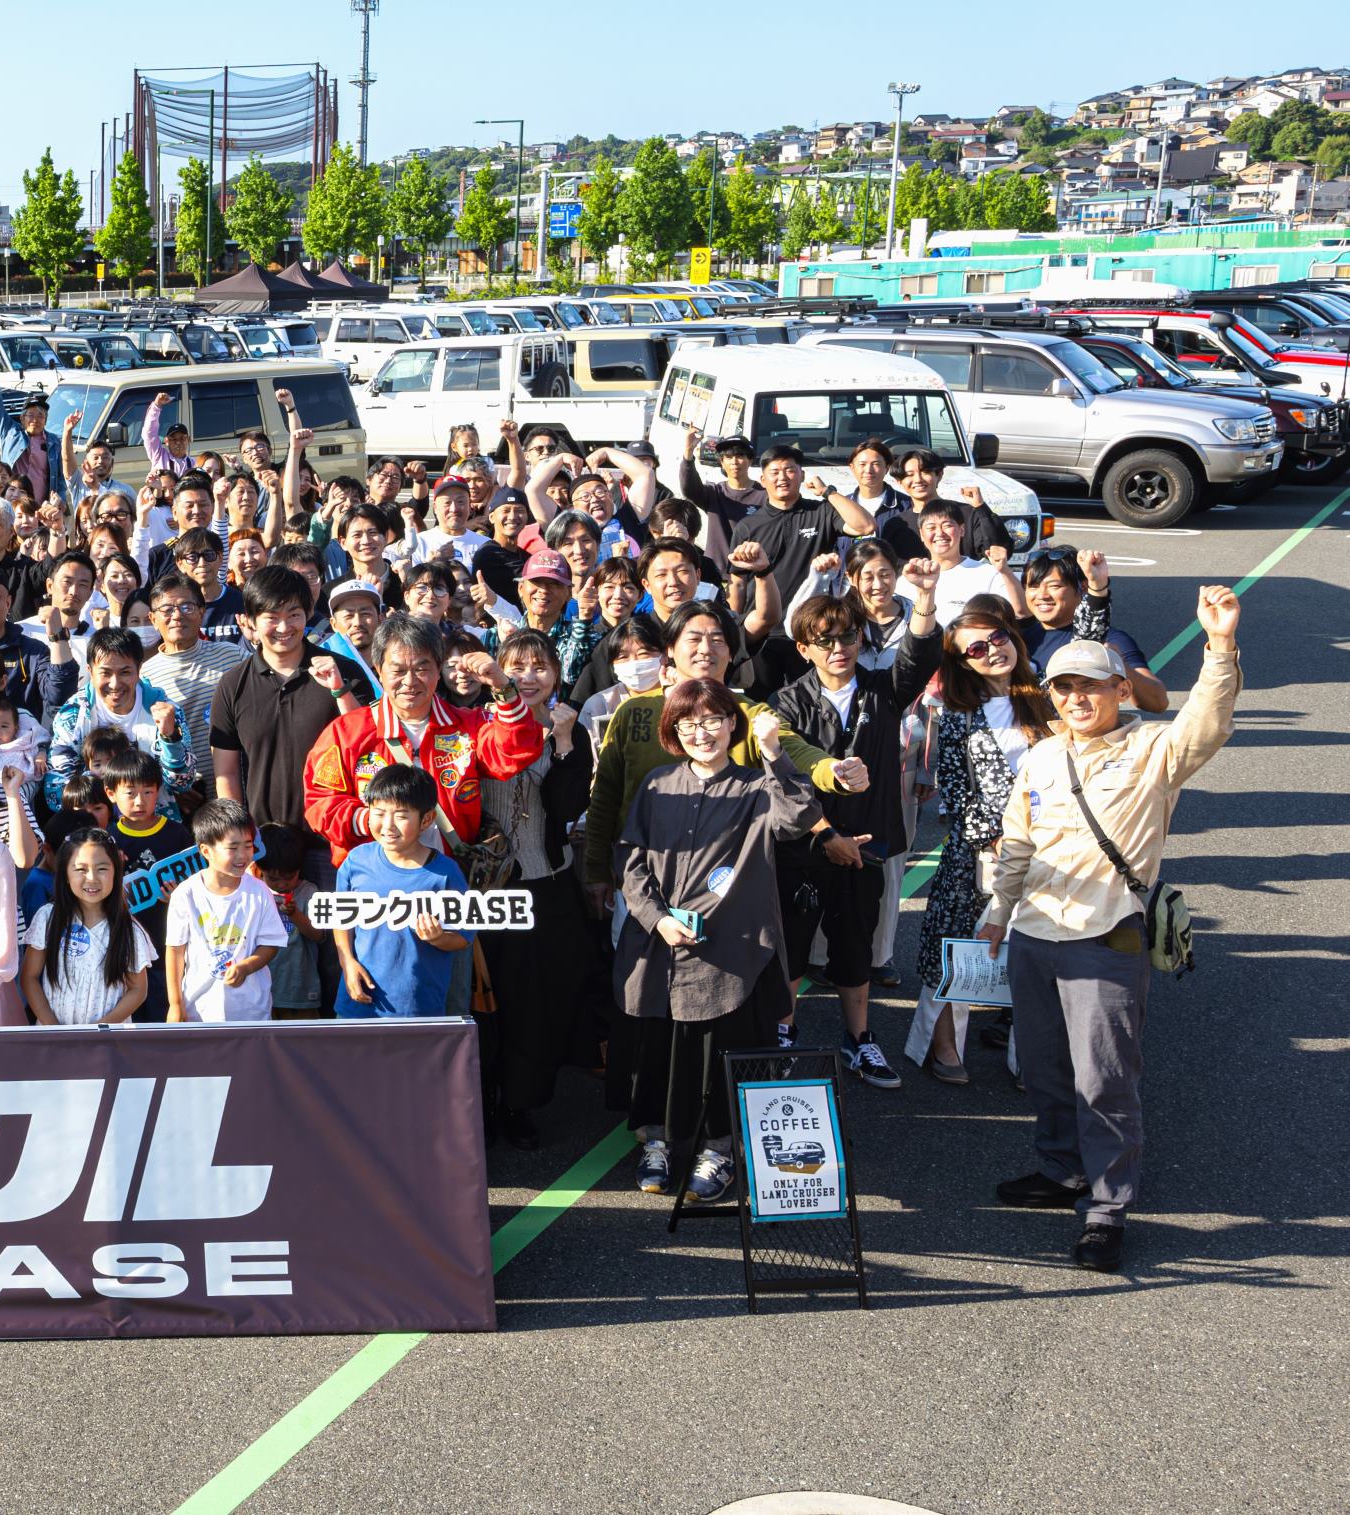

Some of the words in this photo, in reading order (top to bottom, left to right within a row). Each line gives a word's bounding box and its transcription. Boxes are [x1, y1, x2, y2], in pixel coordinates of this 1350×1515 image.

[710, 869, 730, 887] GUEST
[763, 1098, 779, 1116] LAND
[781, 1096, 814, 1115] CRUISER
[759, 1118, 820, 1132] COFFEE
[773, 1178, 800, 1189] ONLY
[803, 1177, 823, 1188] FOR
[762, 1188, 790, 1199] LAND
[792, 1187, 835, 1198] CRUISER
[780, 1198, 818, 1209] LOVERS
